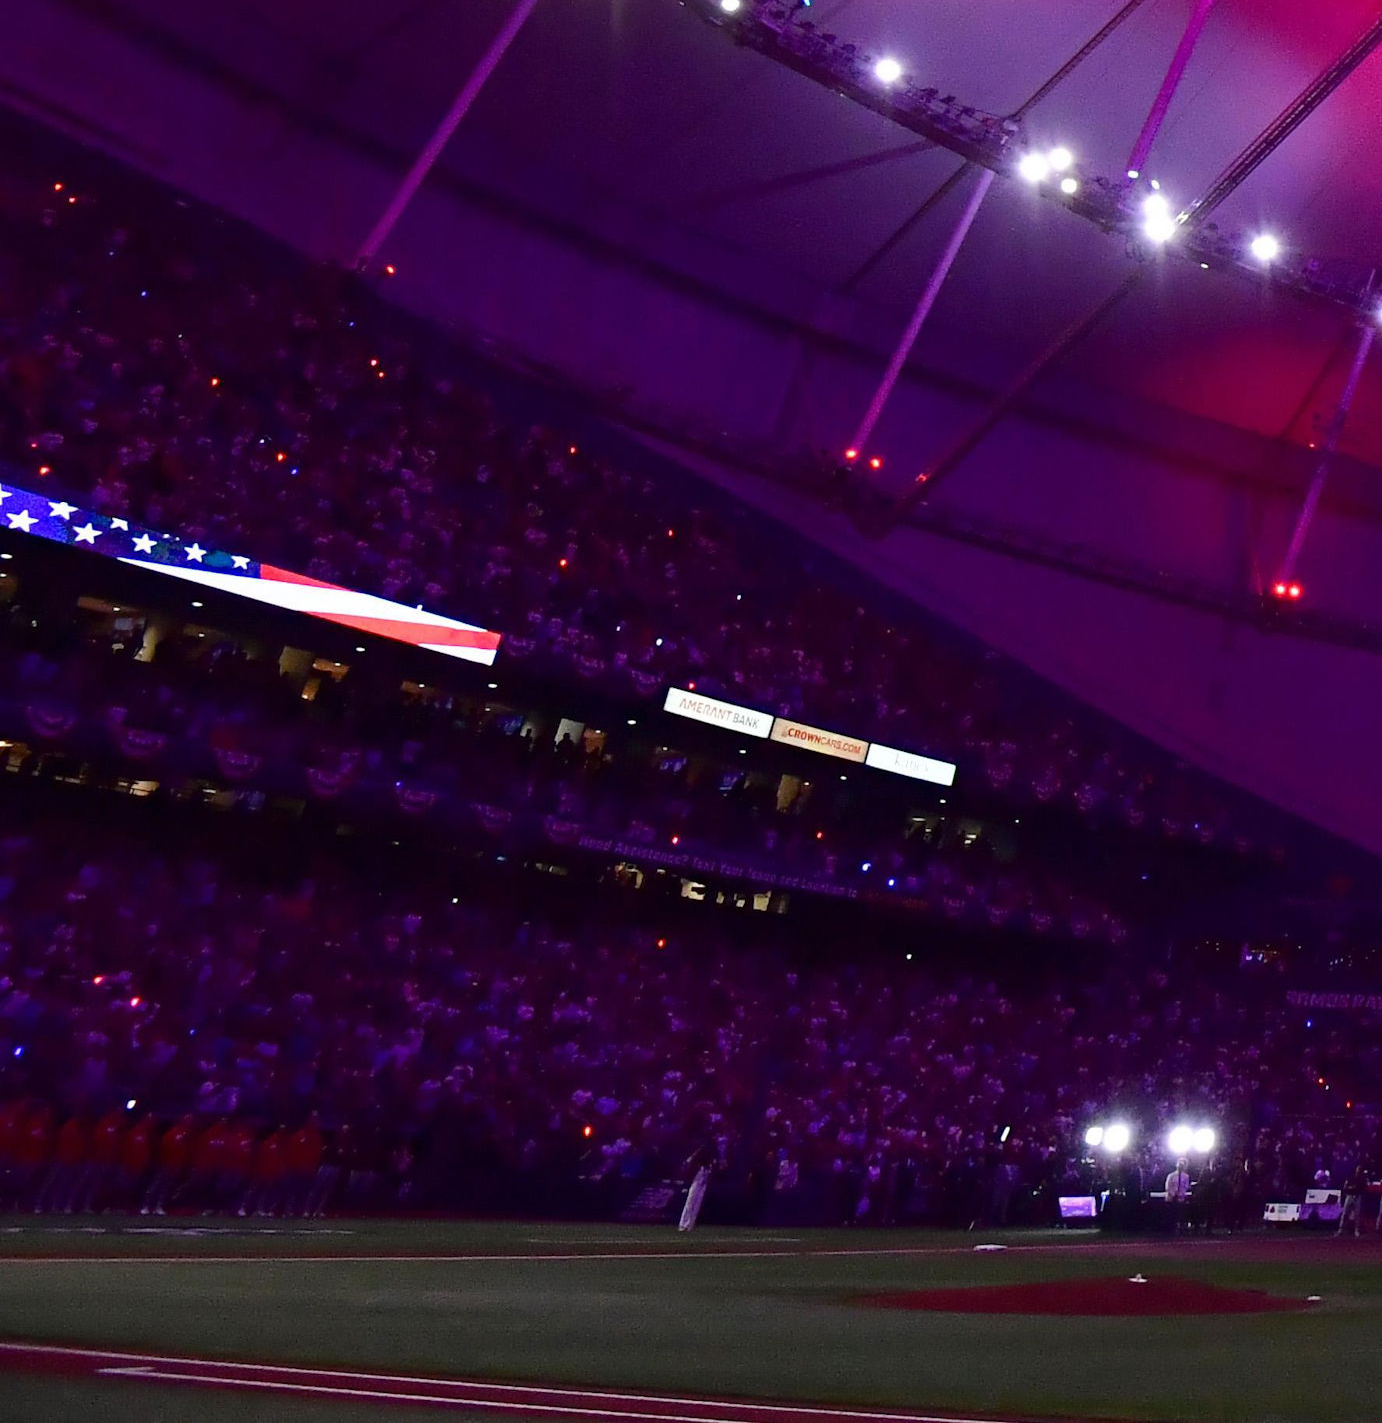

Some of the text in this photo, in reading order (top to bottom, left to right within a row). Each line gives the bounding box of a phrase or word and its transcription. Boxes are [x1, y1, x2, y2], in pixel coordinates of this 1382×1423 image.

[679, 698, 760, 729] AMERANT BANK
[788, 728, 862, 754] CROWNCARS.COM
